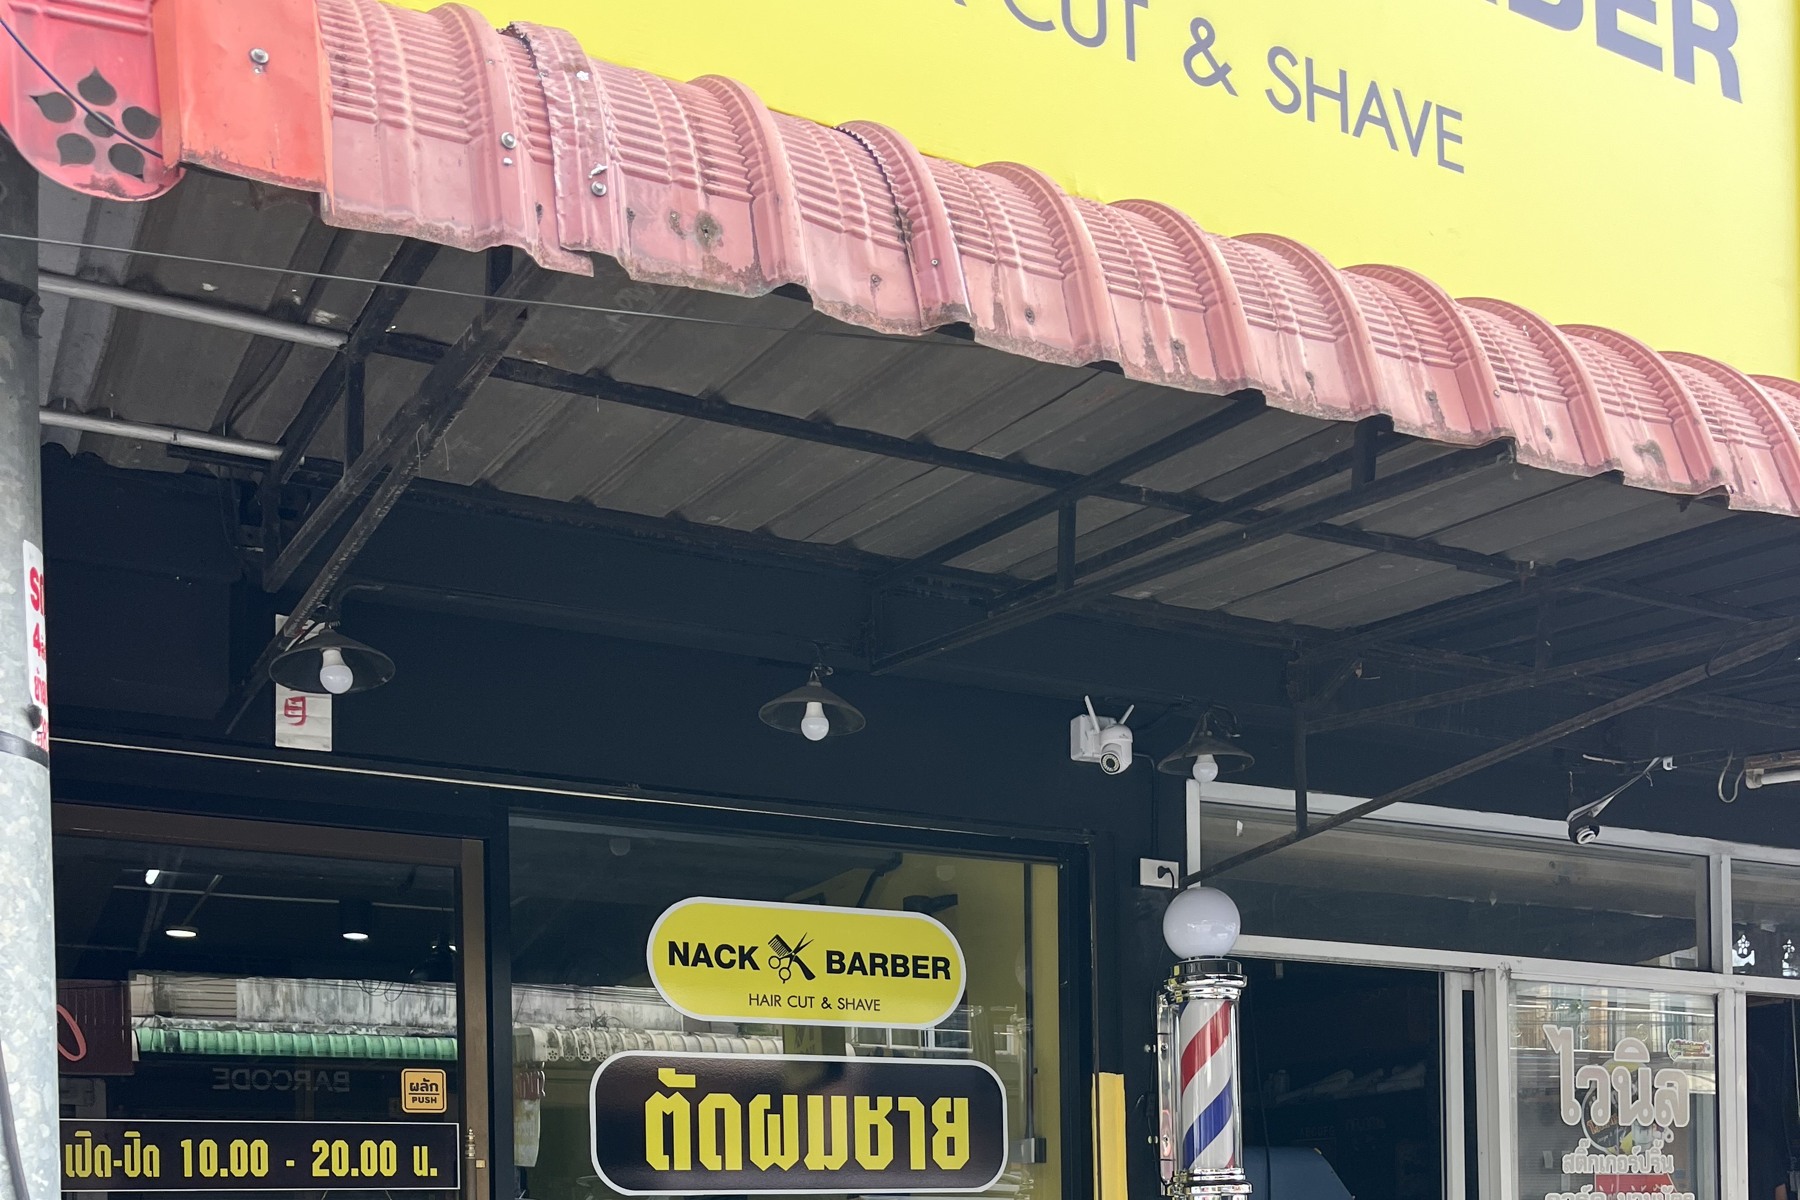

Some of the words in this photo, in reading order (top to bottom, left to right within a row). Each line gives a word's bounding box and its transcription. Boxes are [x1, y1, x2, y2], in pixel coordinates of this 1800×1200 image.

[1183, 16, 1238, 97] &
[1265, 45, 1465, 174] SHAVE
[668, 940, 760, 971] NACK
[826, 949, 951, 980] BARBER
[749, 993, 782, 1007] HAIR
[787, 995, 815, 1008] CUT
[821, 996, 832, 1010] &
[837, 997, 881, 1012] SHAVE
[409, 1077, 439, 1092] ผลัก
[1543, 1024, 1690, 1128] ไวนิล
[411, 1096, 437, 1104] PUSH
[645, 1068, 970, 1172] ตัดผมชาย
[65, 1130, 160, 1178] เปิด-ปิด
[181, 1139, 269, 1178] 10.00
[311, 1139, 397, 1177] 20.00
[413, 1145, 438, 1177] น.
